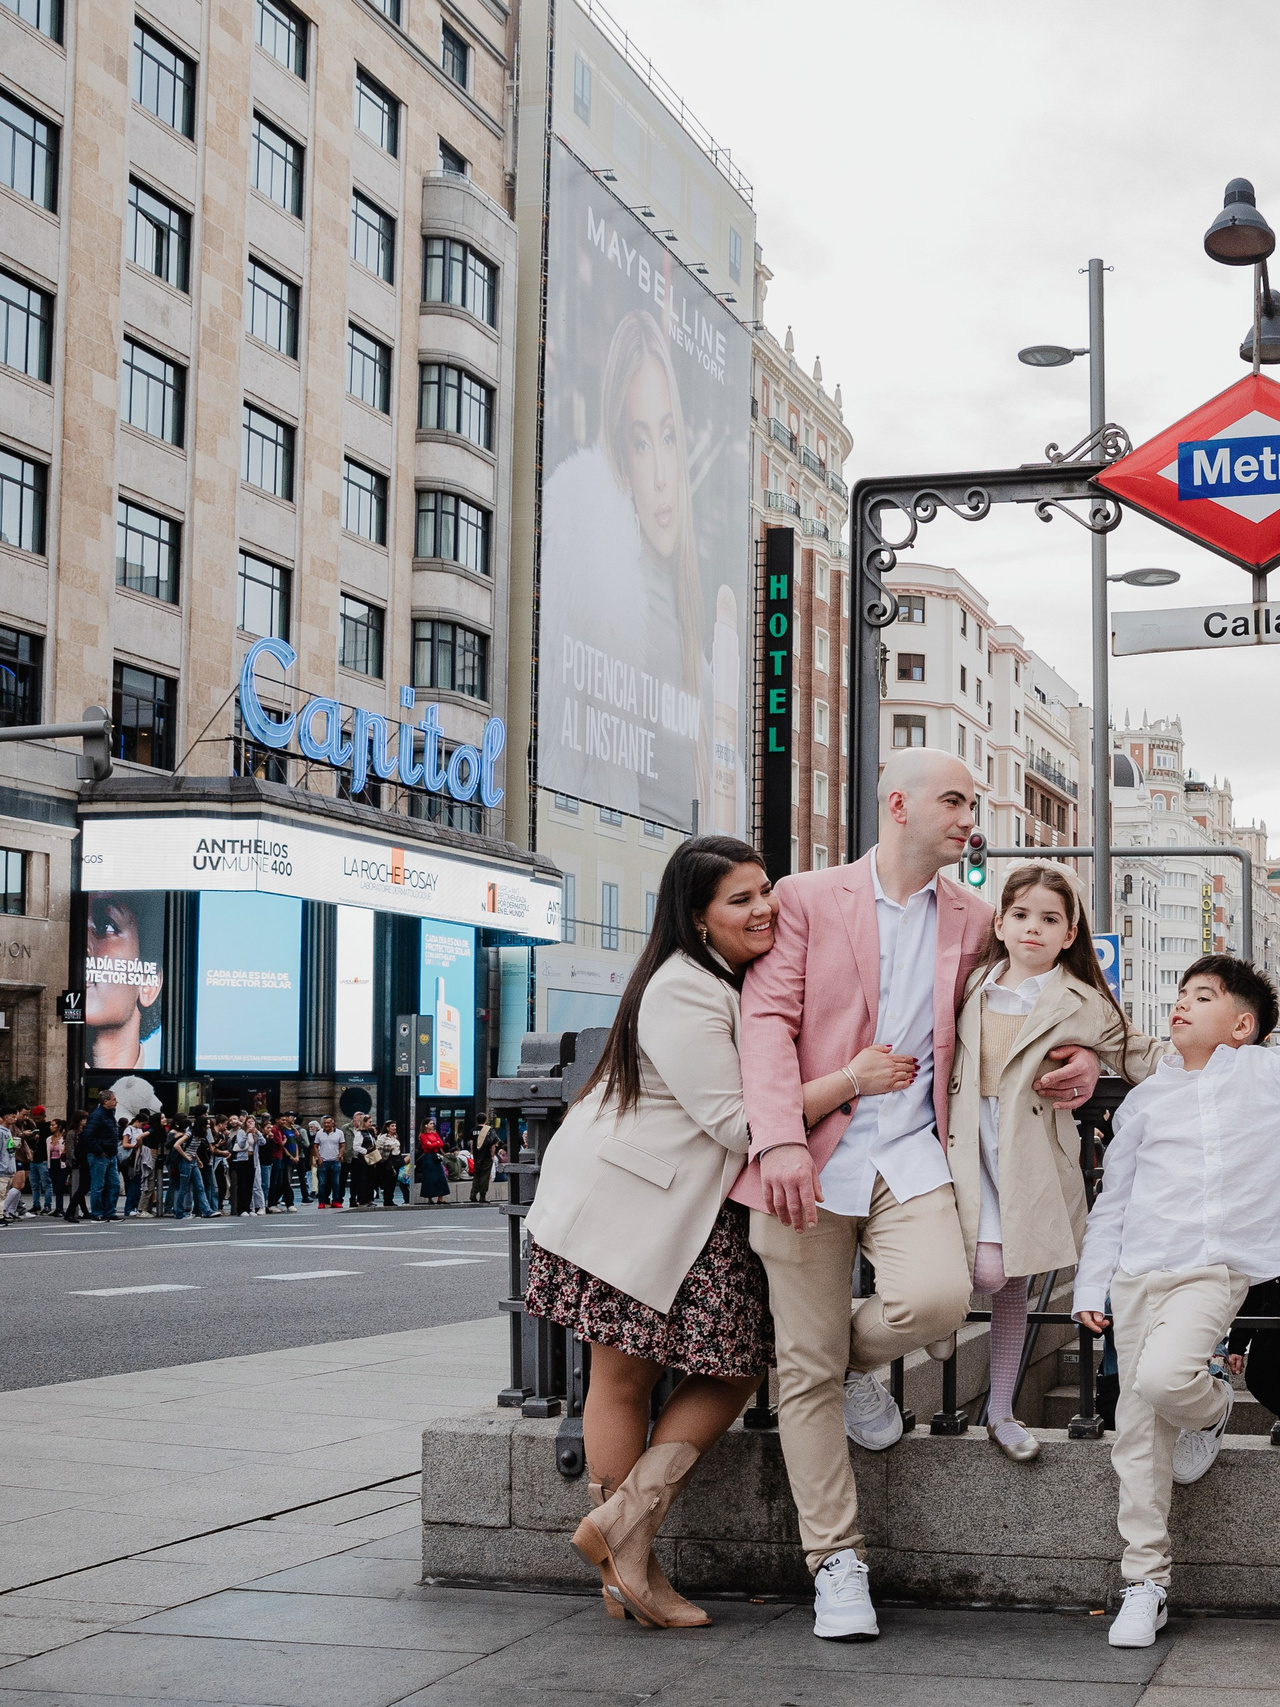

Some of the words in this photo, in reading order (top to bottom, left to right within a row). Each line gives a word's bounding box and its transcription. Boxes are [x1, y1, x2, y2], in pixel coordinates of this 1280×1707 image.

[587, 205, 727, 366] MAYBELLINE
[668, 321, 695, 355] NEW
[695, 345, 725, 385] YORK
[768, 574, 788, 752] HOTEL
[562, 634, 638, 715] POTENCIA
[640, 671, 659, 724] TU
[661, 682, 700, 742] GLOW
[239, 636, 506, 808] Capitol
[561, 696, 582, 751] AL
[585, 705, 659, 780] INSTANTE.
[82, 854, 103, 864] GOS
[196, 838, 289, 858] ANTHELIOS
[192, 855, 269, 873] UVMUNE
[270, 860, 293, 876] 400
[343, 856, 360, 877] LA
[360, 860, 401, 885] ROCHE
[403, 868, 439, 891] POSAY
[1202, 885, 1213, 953] HOTEL
[0, 941, 31, 958] ION
[96, 955, 113, 970] DÍA
[114, 959, 127, 971] ES
[127, 957, 143, 973] DÍA
[143, 962, 157, 974] DE
[206, 969, 231, 978] CADA
[232, 968, 248, 979] DÍA
[248, 971, 260, 979] ES
[261, 970, 276, 980] DÍA
[277, 972, 289, 980] DE
[127, 972, 159, 986] SOLAR
[206, 978, 260, 988] PROTECTOR
[261, 980, 291, 989] SOLAR
